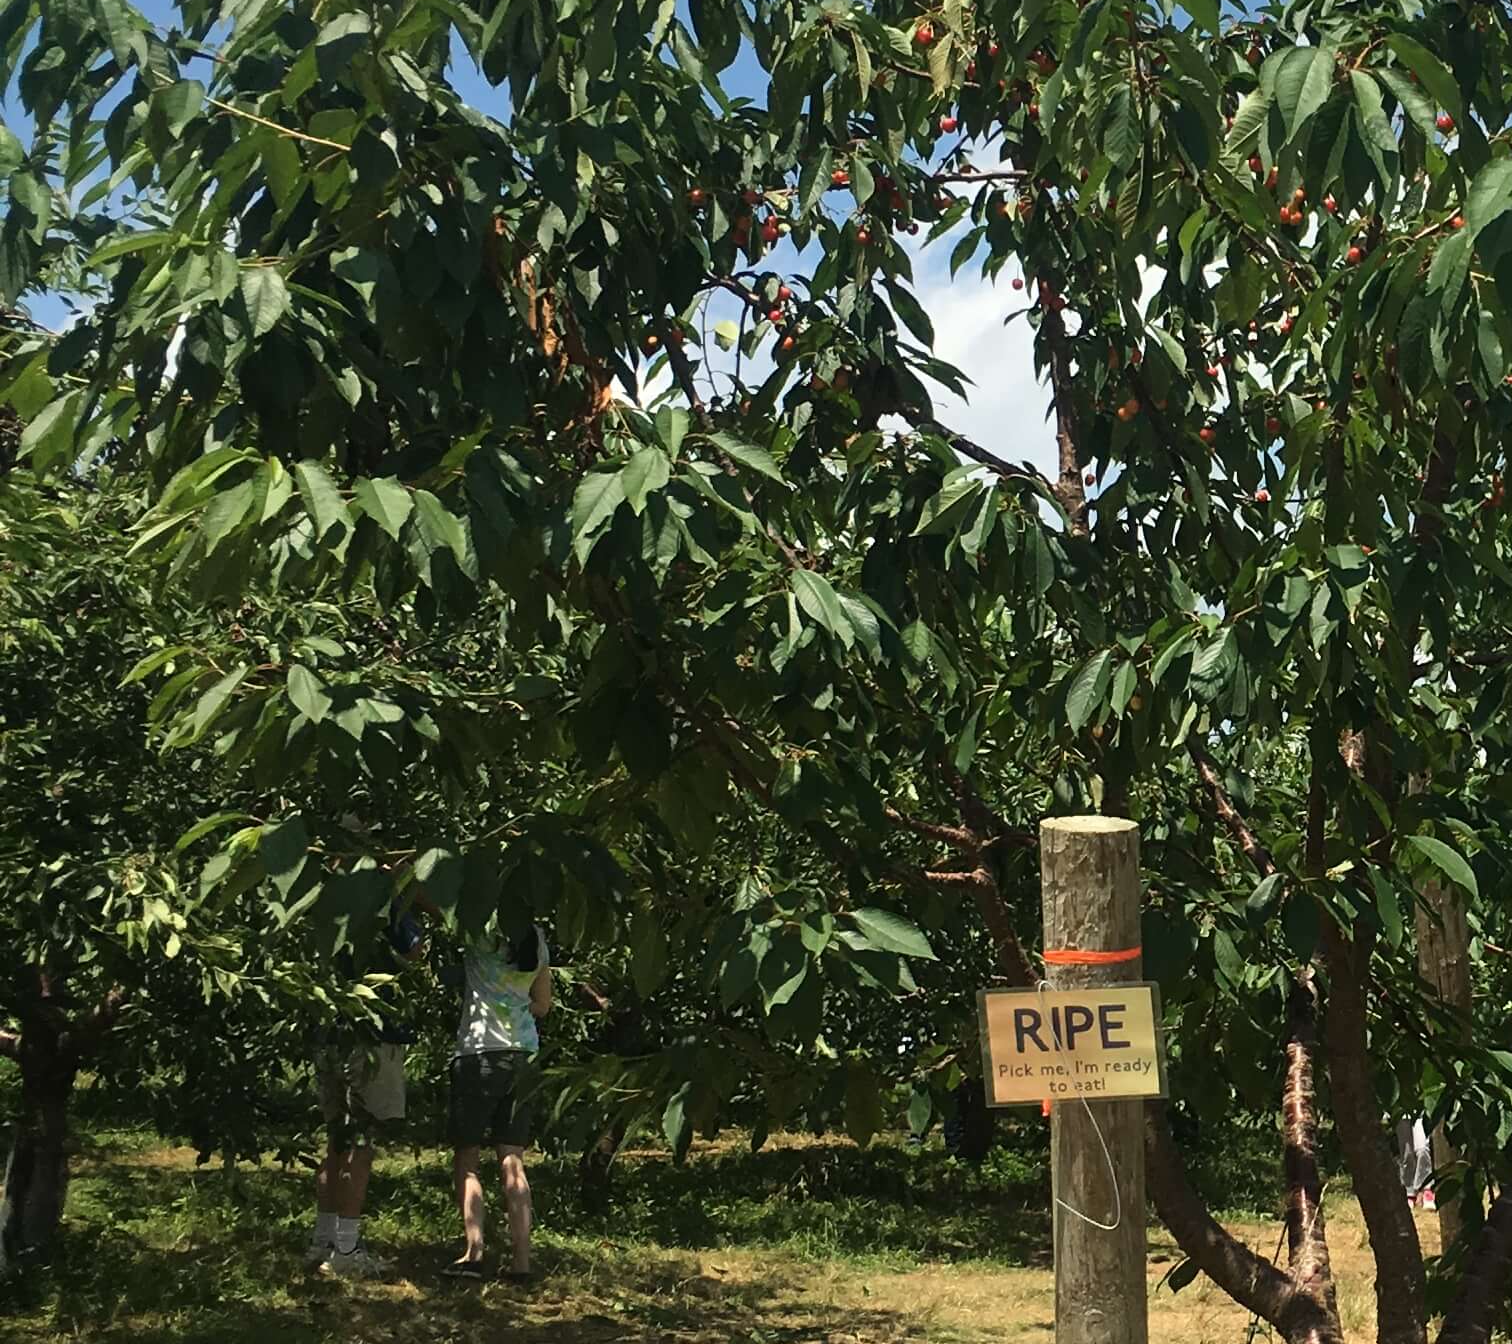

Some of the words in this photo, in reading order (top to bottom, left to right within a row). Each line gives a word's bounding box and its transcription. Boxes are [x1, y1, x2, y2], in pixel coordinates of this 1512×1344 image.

[1013, 1004, 1131, 1053] RIPE
[999, 1063, 1034, 1078] Pick
[1040, 1065, 1070, 1076] me,
[1075, 1060, 1099, 1073] I'm
[1104, 1058, 1152, 1074] ready
[1049, 1081, 1068, 1093] to
[1074, 1077, 1106, 1092] eat!
